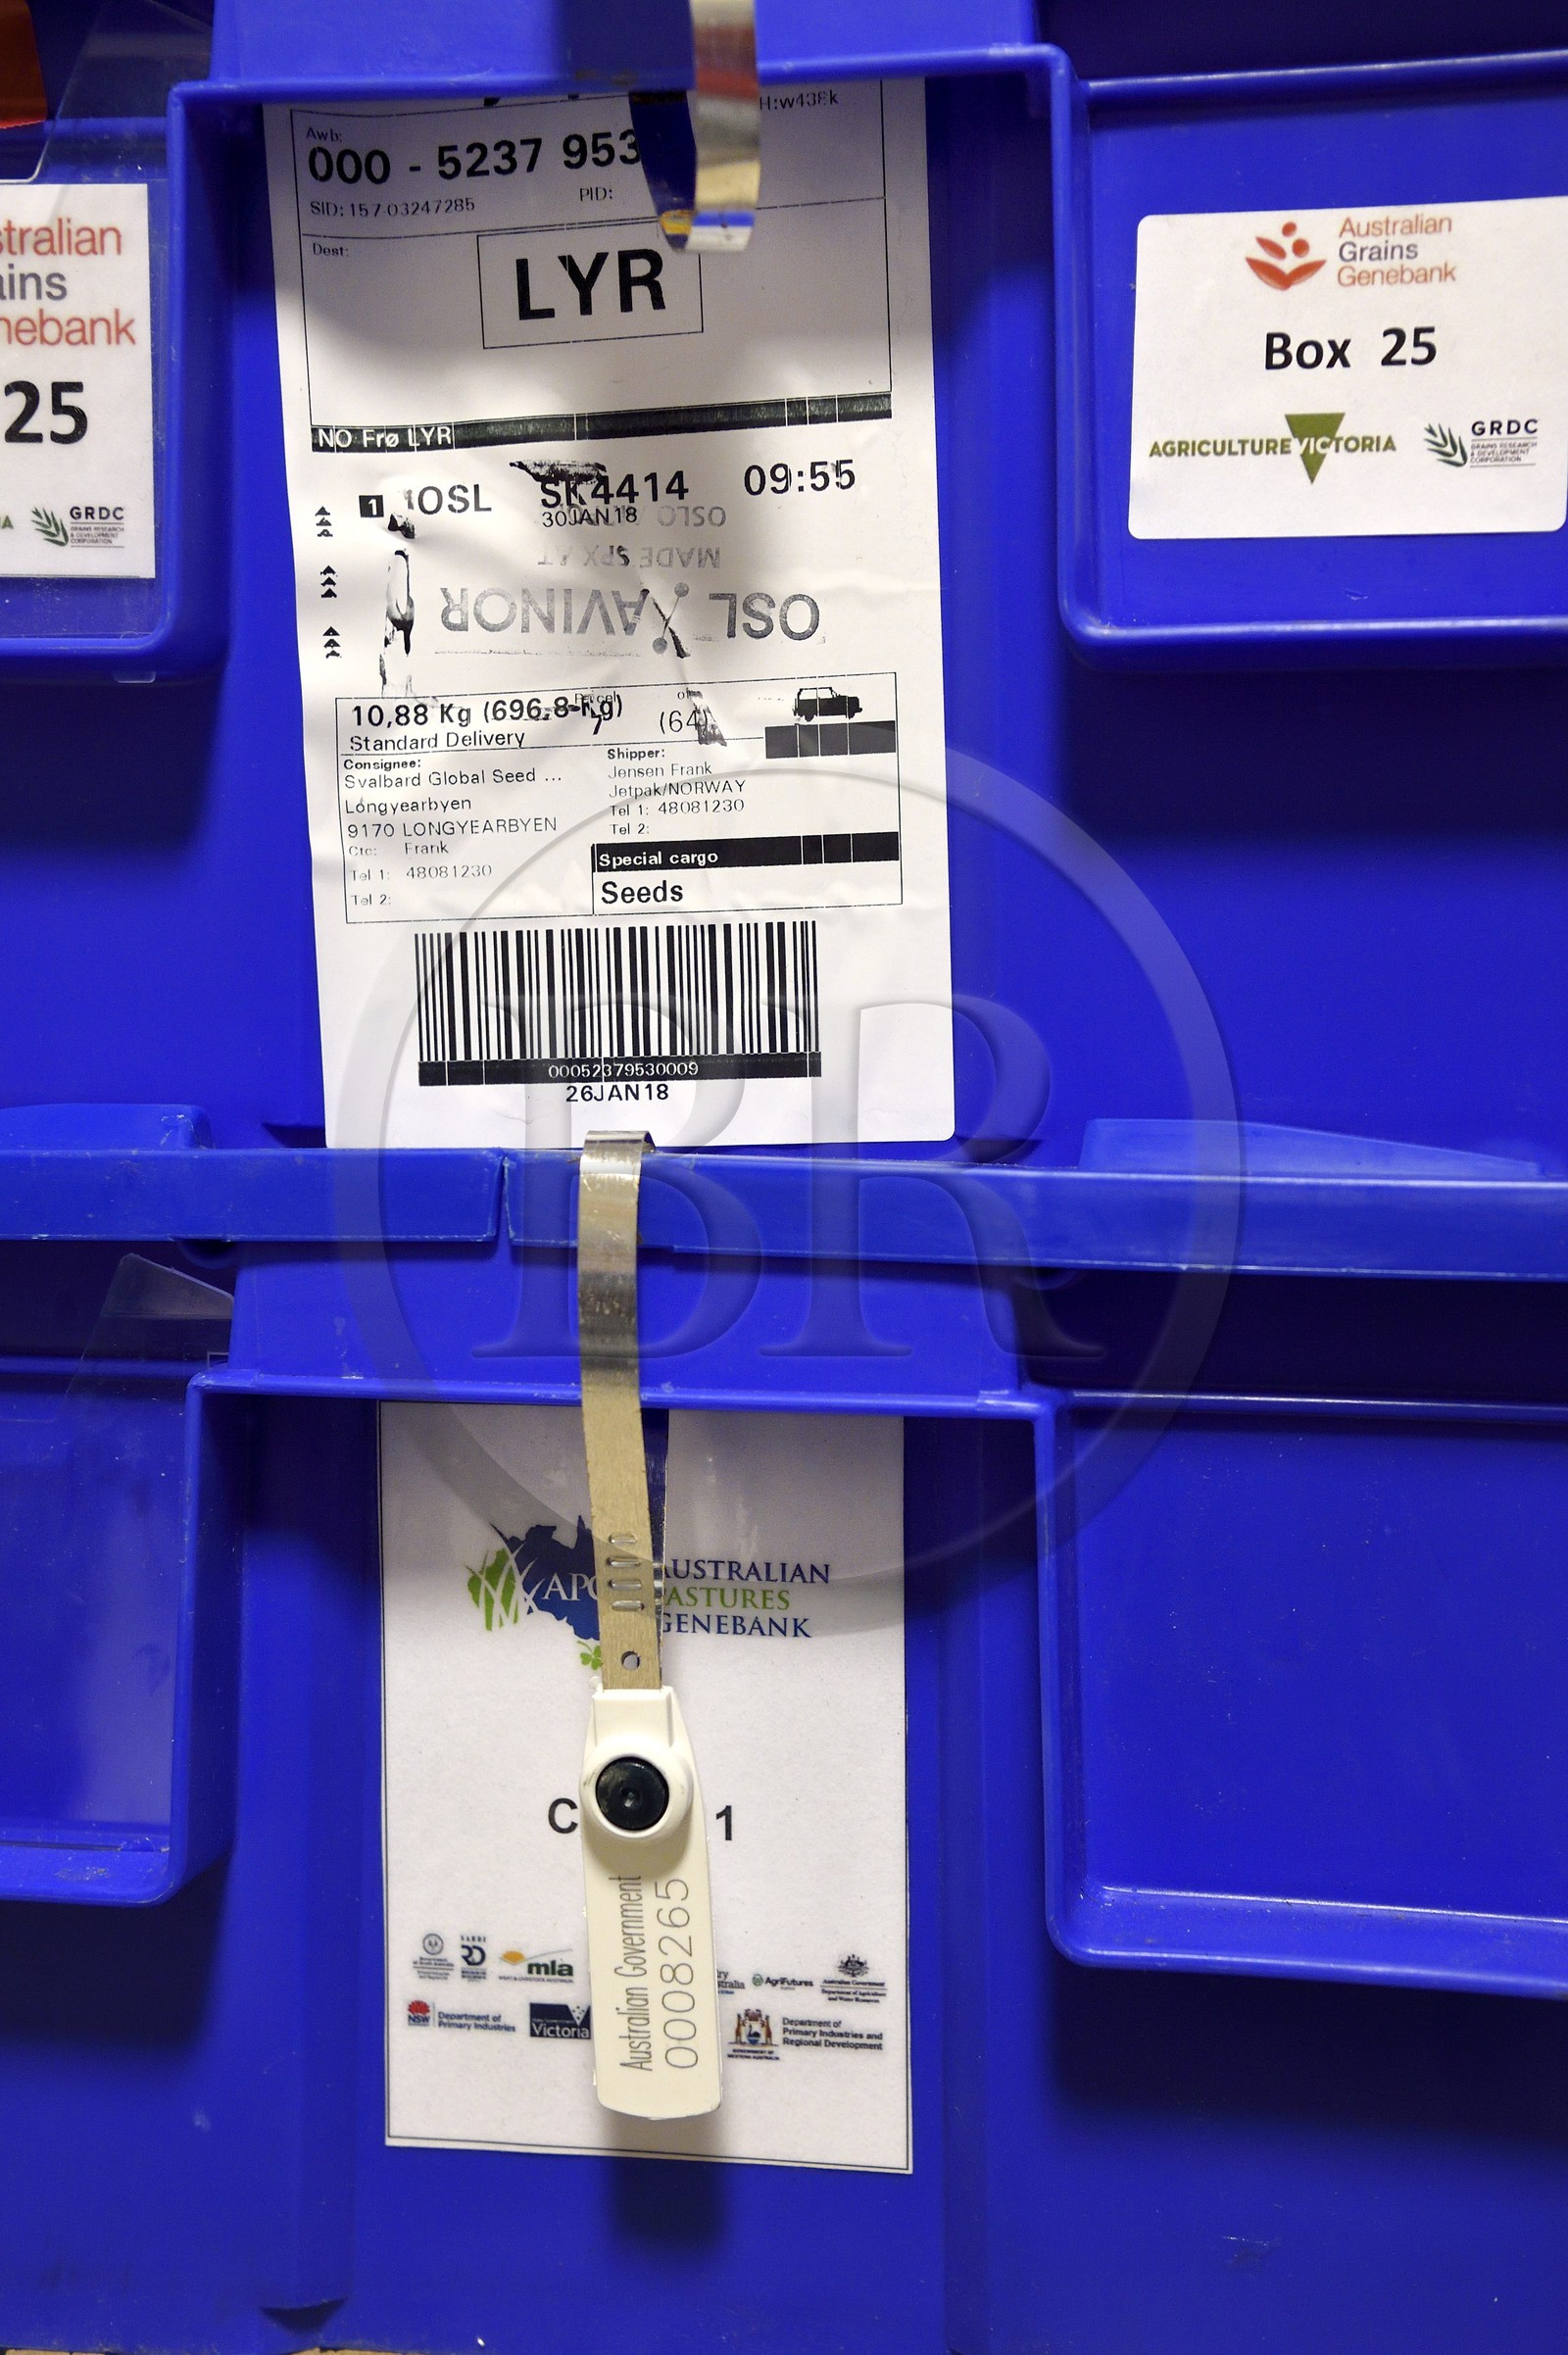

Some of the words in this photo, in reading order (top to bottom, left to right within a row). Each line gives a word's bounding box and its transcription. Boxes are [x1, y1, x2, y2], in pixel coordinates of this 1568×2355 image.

[306, 127, 342, 142] Awb:
[309, 146, 390, 184] 000
[438, 137, 542, 180] 5237
[579, 186, 613, 202] PID:
[1339, 214, 1452, 237] Australian
[313, 243, 350, 258] Dest:
[1339, 241, 1418, 263] Grains
[1337, 262, 1457, 287] Genebank
[515, 248, 664, 321] LYR
[1264, 331, 1351, 370] Box
[1381, 326, 1437, 367] 25
[4, 380, 88, 445] 25
[318, 427, 352, 448] NO
[363, 427, 400, 448] Frø
[408, 425, 452, 447] LYR
[1471, 418, 1538, 436] GRDC
[1149, 437, 1292, 458] AGRICULTURE
[1294, 434, 1396, 456] VICTORIA
[541, 470, 689, 508] SK4414
[744, 460, 856, 497] 09:55
[368, 498, 378, 515] 1
[417, 483, 492, 515] OSL
[70, 506, 124, 520] GRDC
[640, 547, 720, 568] MADE
[440, 587, 650, 636] AVINOR
[709, 592, 821, 641] OSL
[353, 704, 429, 728] 10,88
[440, 703, 471, 727] Kg
[350, 734, 438, 752] Standard
[447, 730, 526, 749] Delivery
[608, 747, 665, 760] Shipper:
[343, 759, 421, 771] Consignee:
[608, 764, 664, 779] Jensen
[671, 762, 712, 776] Frank
[345, 771, 421, 789] Svalbard
[429, 769, 485, 786] Global
[493, 768, 536, 783] Seed
[609, 780, 746, 800] Jetpak/NORWAY
[345, 798, 471, 816] Longyearbyen
[611, 804, 630, 816] Tel
[638, 804, 649, 816] 1:
[658, 799, 745, 815] 48081230
[347, 823, 395, 838] 9170
[403, 817, 558, 837] LONGYEARBYEN
[611, 823, 630, 835] Tel
[638, 823, 649, 835] 2:
[349, 845, 377, 857] Ctc:
[405, 841, 450, 855] Frank
[599, 851, 662, 869] Special
[669, 852, 718, 867] cargo
[350, 869, 370, 881] Tel
[406, 864, 492, 879] 48081230
[351, 894, 372, 906] Tel
[379, 894, 392, 906] 2:
[601, 880, 684, 905] Seeds
[548, 1061, 699, 1078] 00052379530009
[664, 1586, 791, 1610] ASTURES
[715, 1804, 733, 1840] 1
[609, 1875, 648, 1978] Government
[527, 1960, 573, 1977] mla
[654, 1879, 699, 2069] 0008265
[764, 1976, 814, 1987] AgriFutures
[408, 2015, 430, 2024] NSW
[438, 2012, 490, 2023] Department
[438, 2021, 471, 2031] Primary
[474, 2022, 516, 2033] Industries
[782, 2017, 831, 2029] Department
[532, 2022, 590, 2038] Victoria
[615, 1987, 654, 2072] Australian
[782, 2027, 817, 2038] Primary
[819, 2029, 863, 2039] Industries
[866, 2032, 883, 2040] and
[782, 2037, 821, 2047] Regional
[824, 2039, 883, 2051] Development
